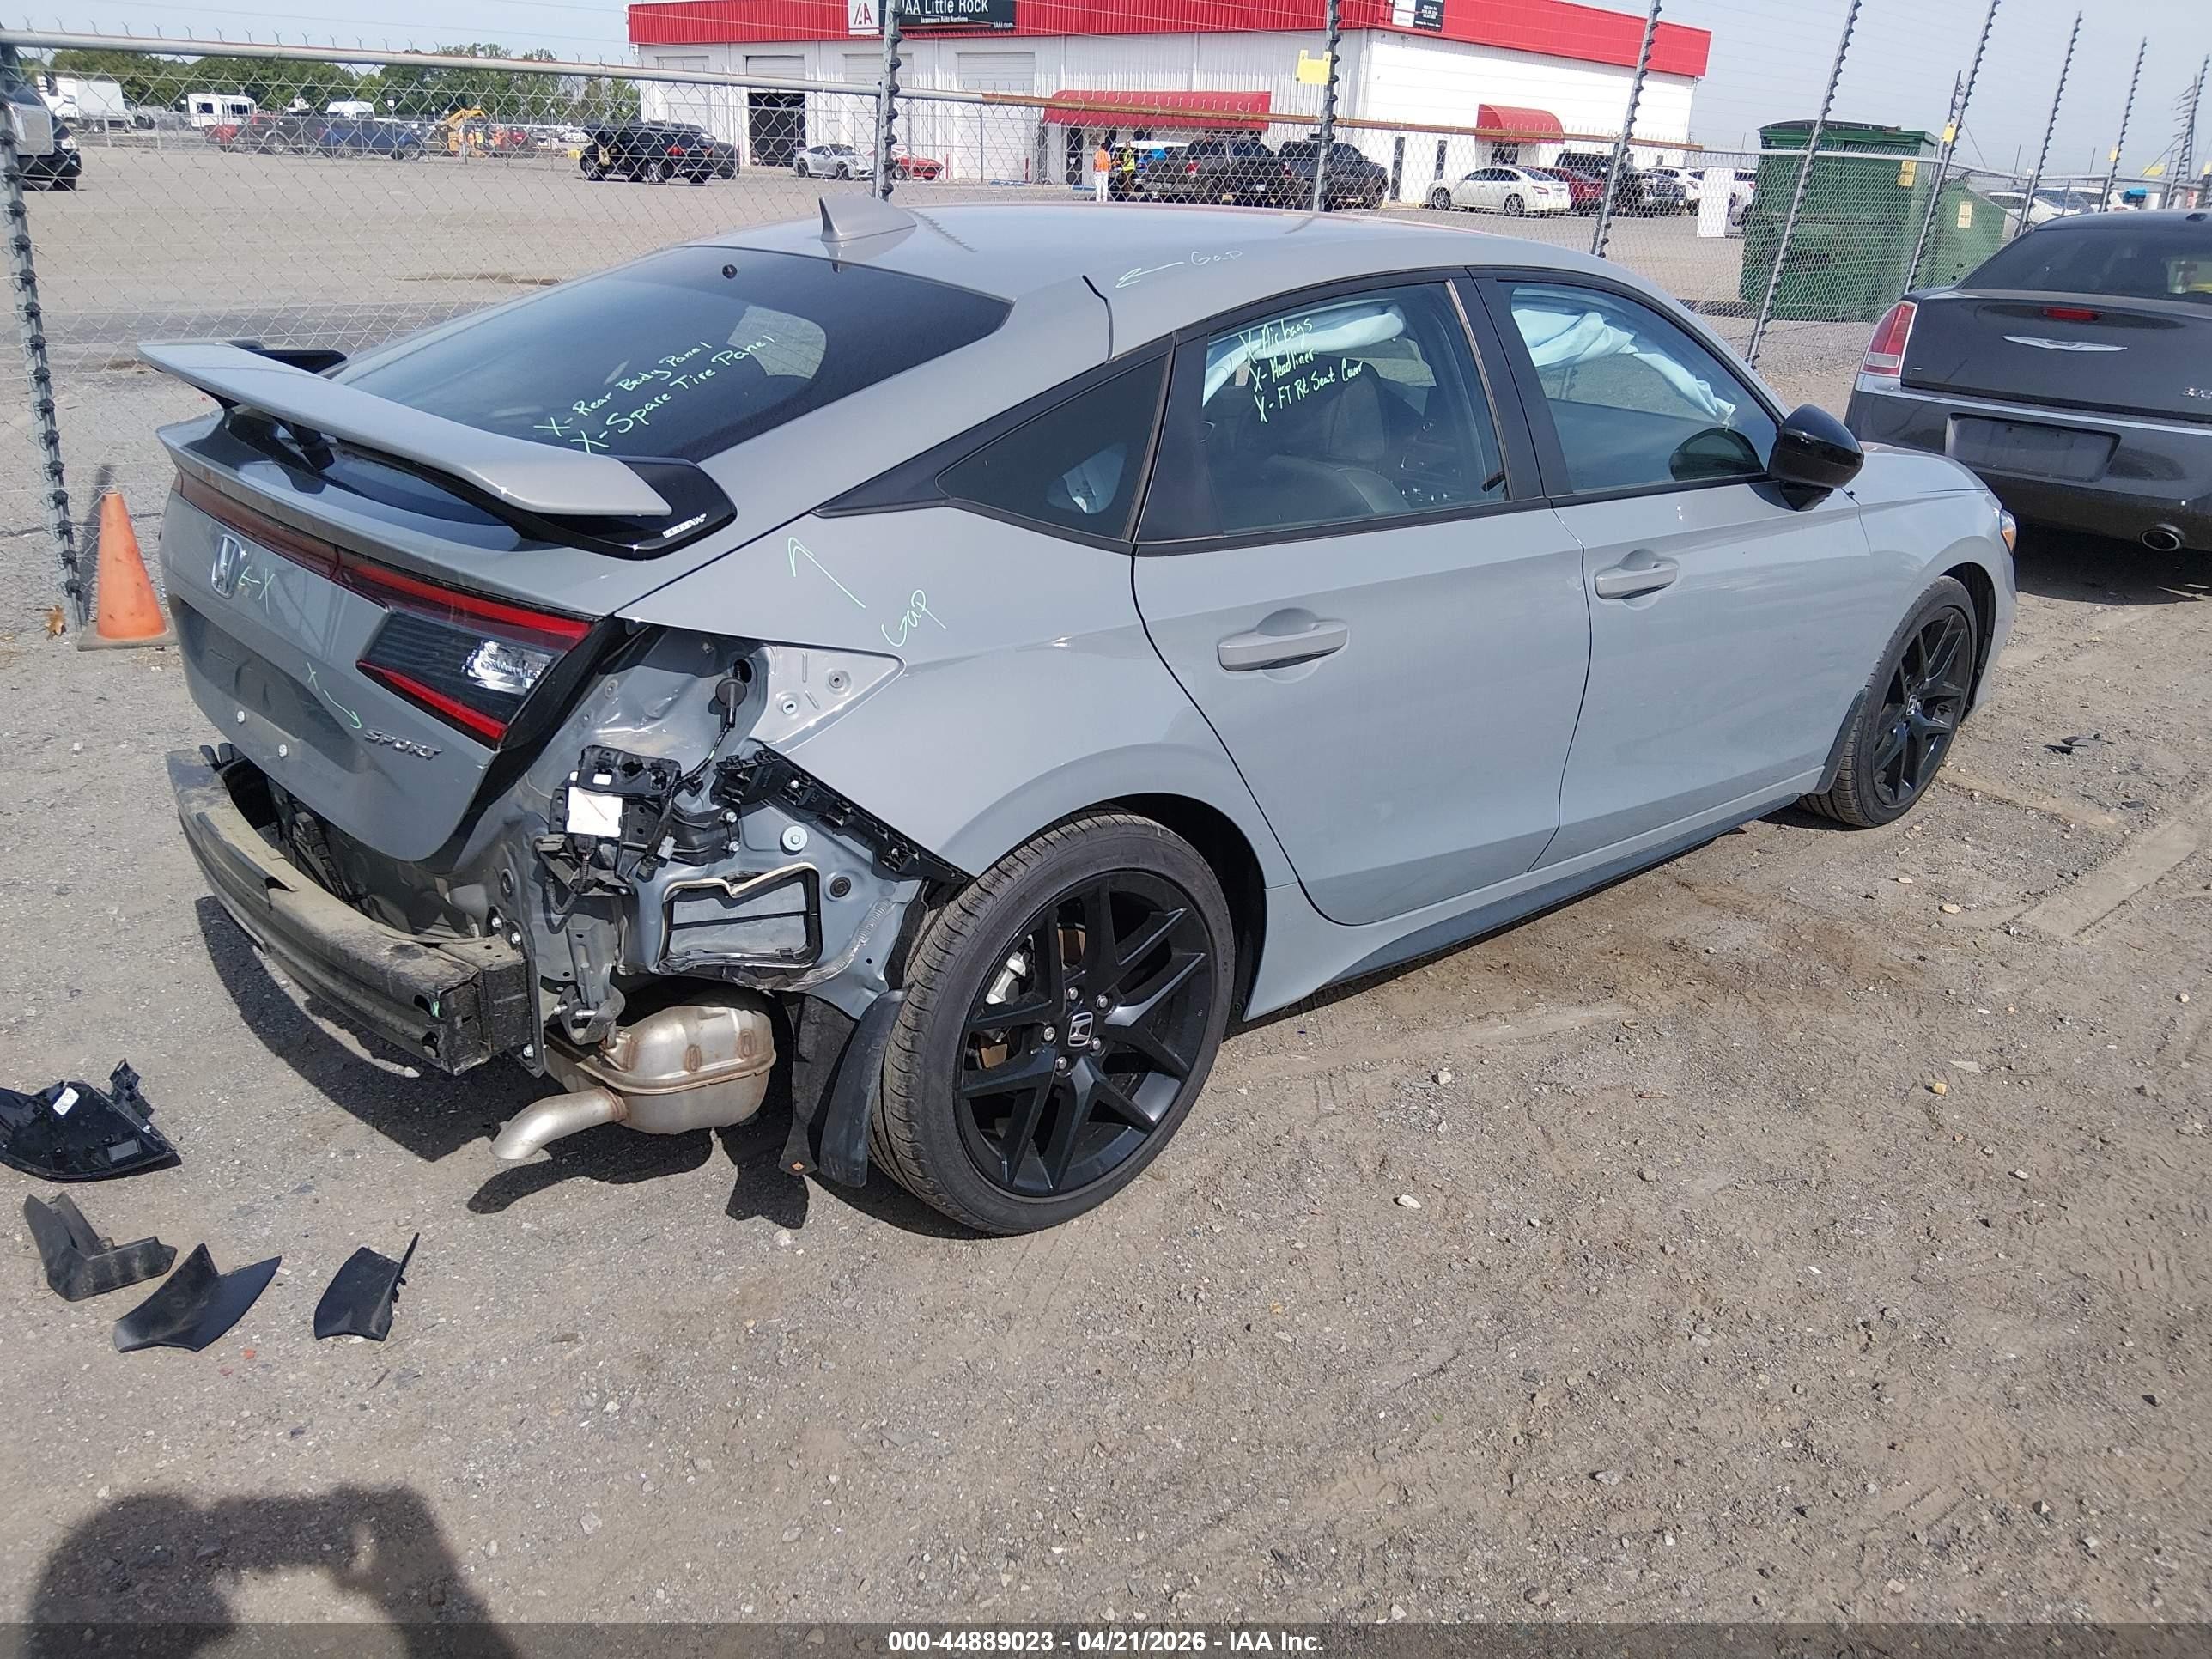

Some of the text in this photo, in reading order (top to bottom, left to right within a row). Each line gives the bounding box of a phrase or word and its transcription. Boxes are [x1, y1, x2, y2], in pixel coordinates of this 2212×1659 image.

[925, 0, 954, 15] Little
[958, 0, 989, 14] Rock
[572, 392, 612, 416] Rear
[615, 368, 672, 391] Body
[658, 342, 713, 367] Panel
[1269, 348, 1315, 383] Headliner
[1310, 366, 1336, 391] Seat
[605, 392, 672, 434] Spare
[669, 368, 716, 390] Tire
[711, 334, 775, 366] Panel
[364, 729, 443, 760] SPORT
